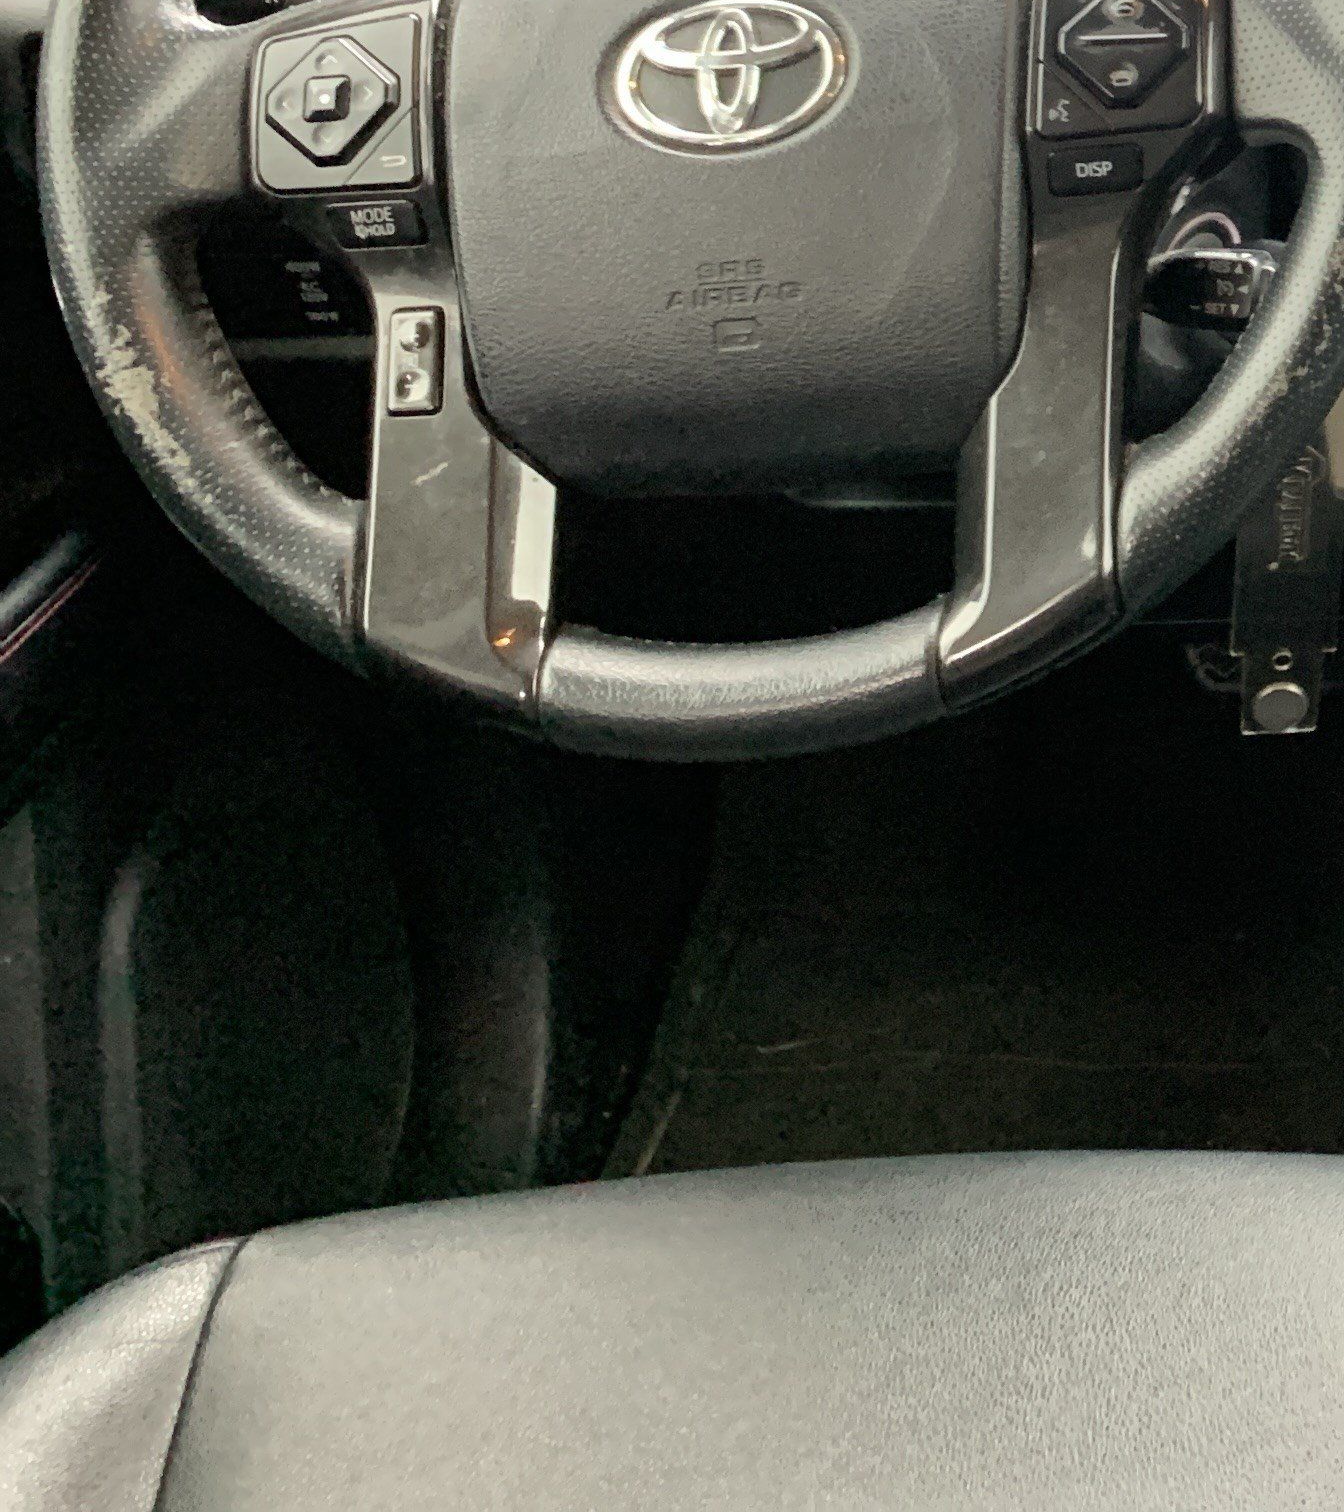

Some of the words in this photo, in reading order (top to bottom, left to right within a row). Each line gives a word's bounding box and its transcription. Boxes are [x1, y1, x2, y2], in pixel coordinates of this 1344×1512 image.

[1075, 160, 1113, 178] DISP
[350, 206, 395, 224] MODE
[367, 223, 396, 237] HOLD
[664, 281, 802, 311] AIRBAG
